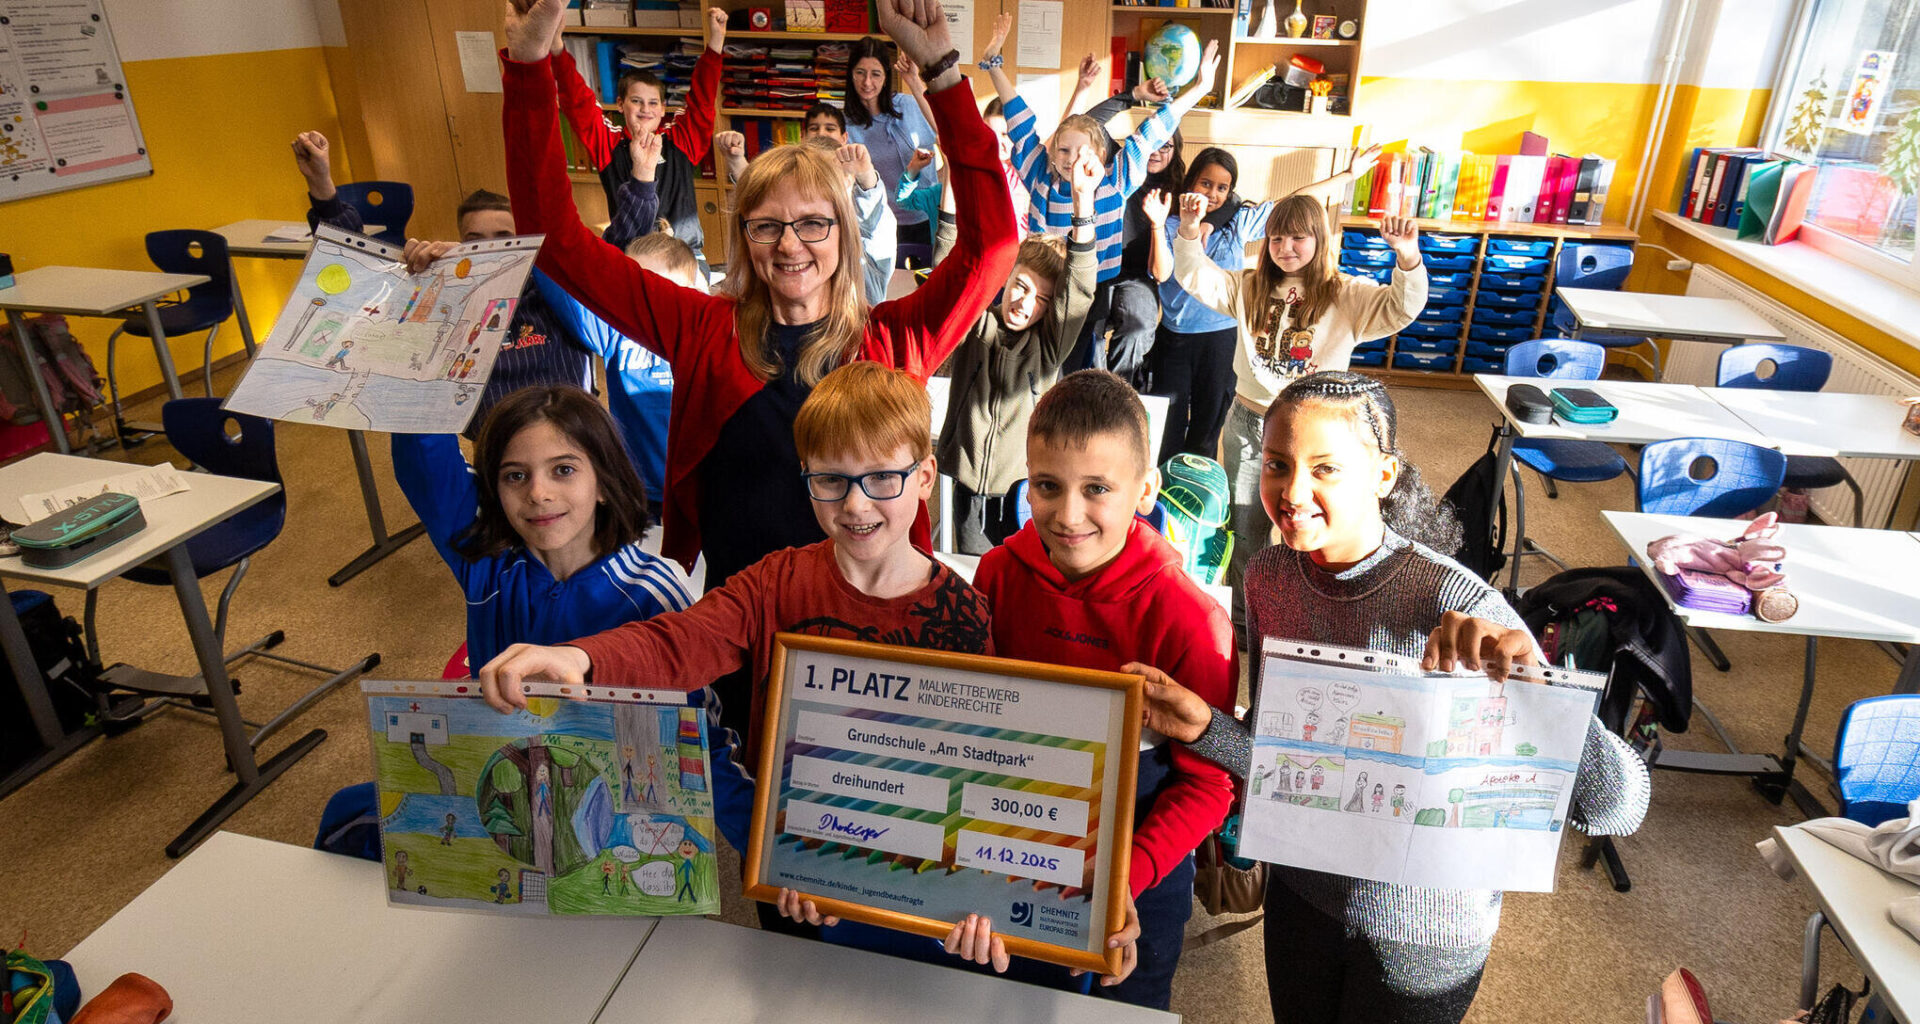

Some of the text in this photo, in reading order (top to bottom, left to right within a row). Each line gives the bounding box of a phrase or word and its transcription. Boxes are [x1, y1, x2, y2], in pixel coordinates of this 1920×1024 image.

[804, 664, 911, 702] 1. PLATZ
[918, 678, 1020, 703] MALWETTBEWERB
[917, 692, 1003, 715] KINDERRECHTE
[847, 728, 926, 752] Grundschule
[832, 772, 905, 795] dreihundert
[991, 797, 1058, 821] 300,00 €
[976, 846, 1060, 870] 11.12.2025
[1041, 905, 1080, 920] CHEMNITZ
